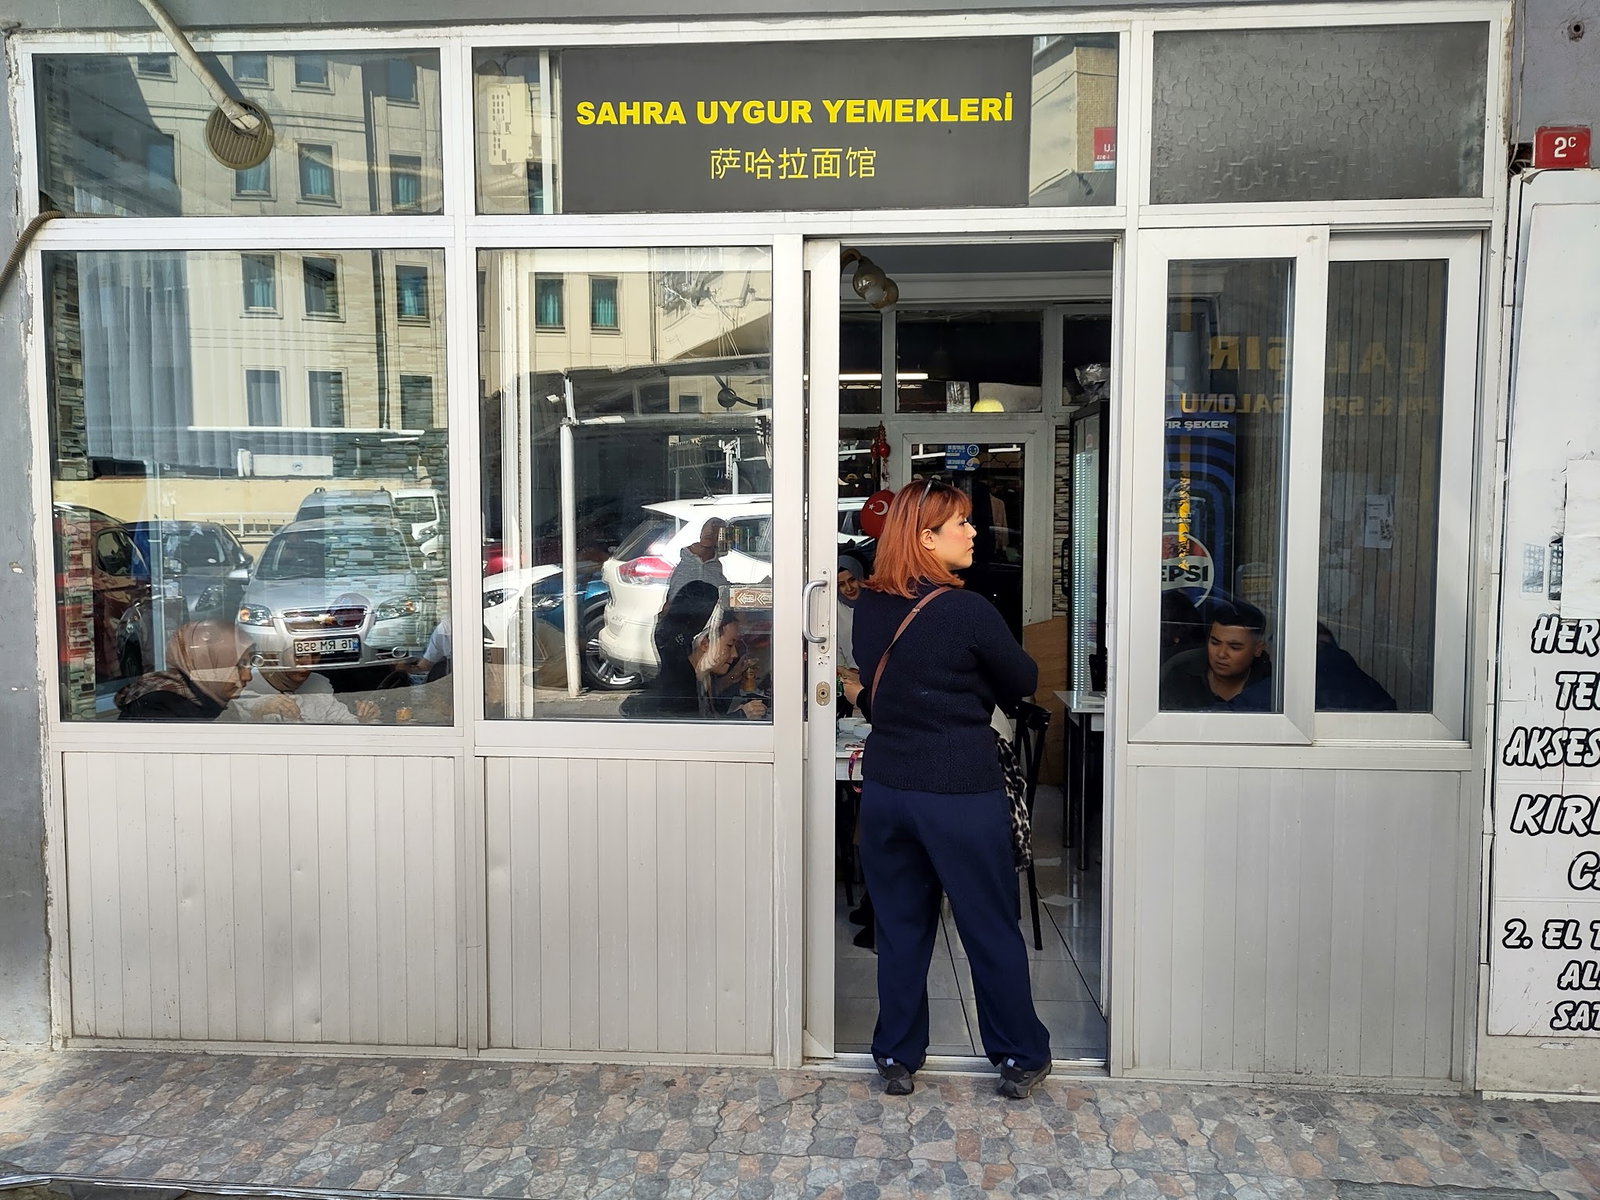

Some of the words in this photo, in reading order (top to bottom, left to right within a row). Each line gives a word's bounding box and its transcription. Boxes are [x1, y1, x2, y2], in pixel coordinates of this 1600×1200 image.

[576, 101, 686, 125] SAHRA
[696, 100, 813, 125] UYGUR
[821, 91, 1013, 123] YEMEKLERİ
[710, 147, 877, 180] 萨哈拉面馆
[1184, 420, 1229, 432] ŞEKER
[1531, 614, 1600, 657] HER
[1556, 671, 1600, 710] TE
[1503, 726, 1600, 770] AKSES
[1502, 918, 1533, 949] 2.
[1542, 919, 1582, 949] EL
[1557, 960, 1600, 990] AL
